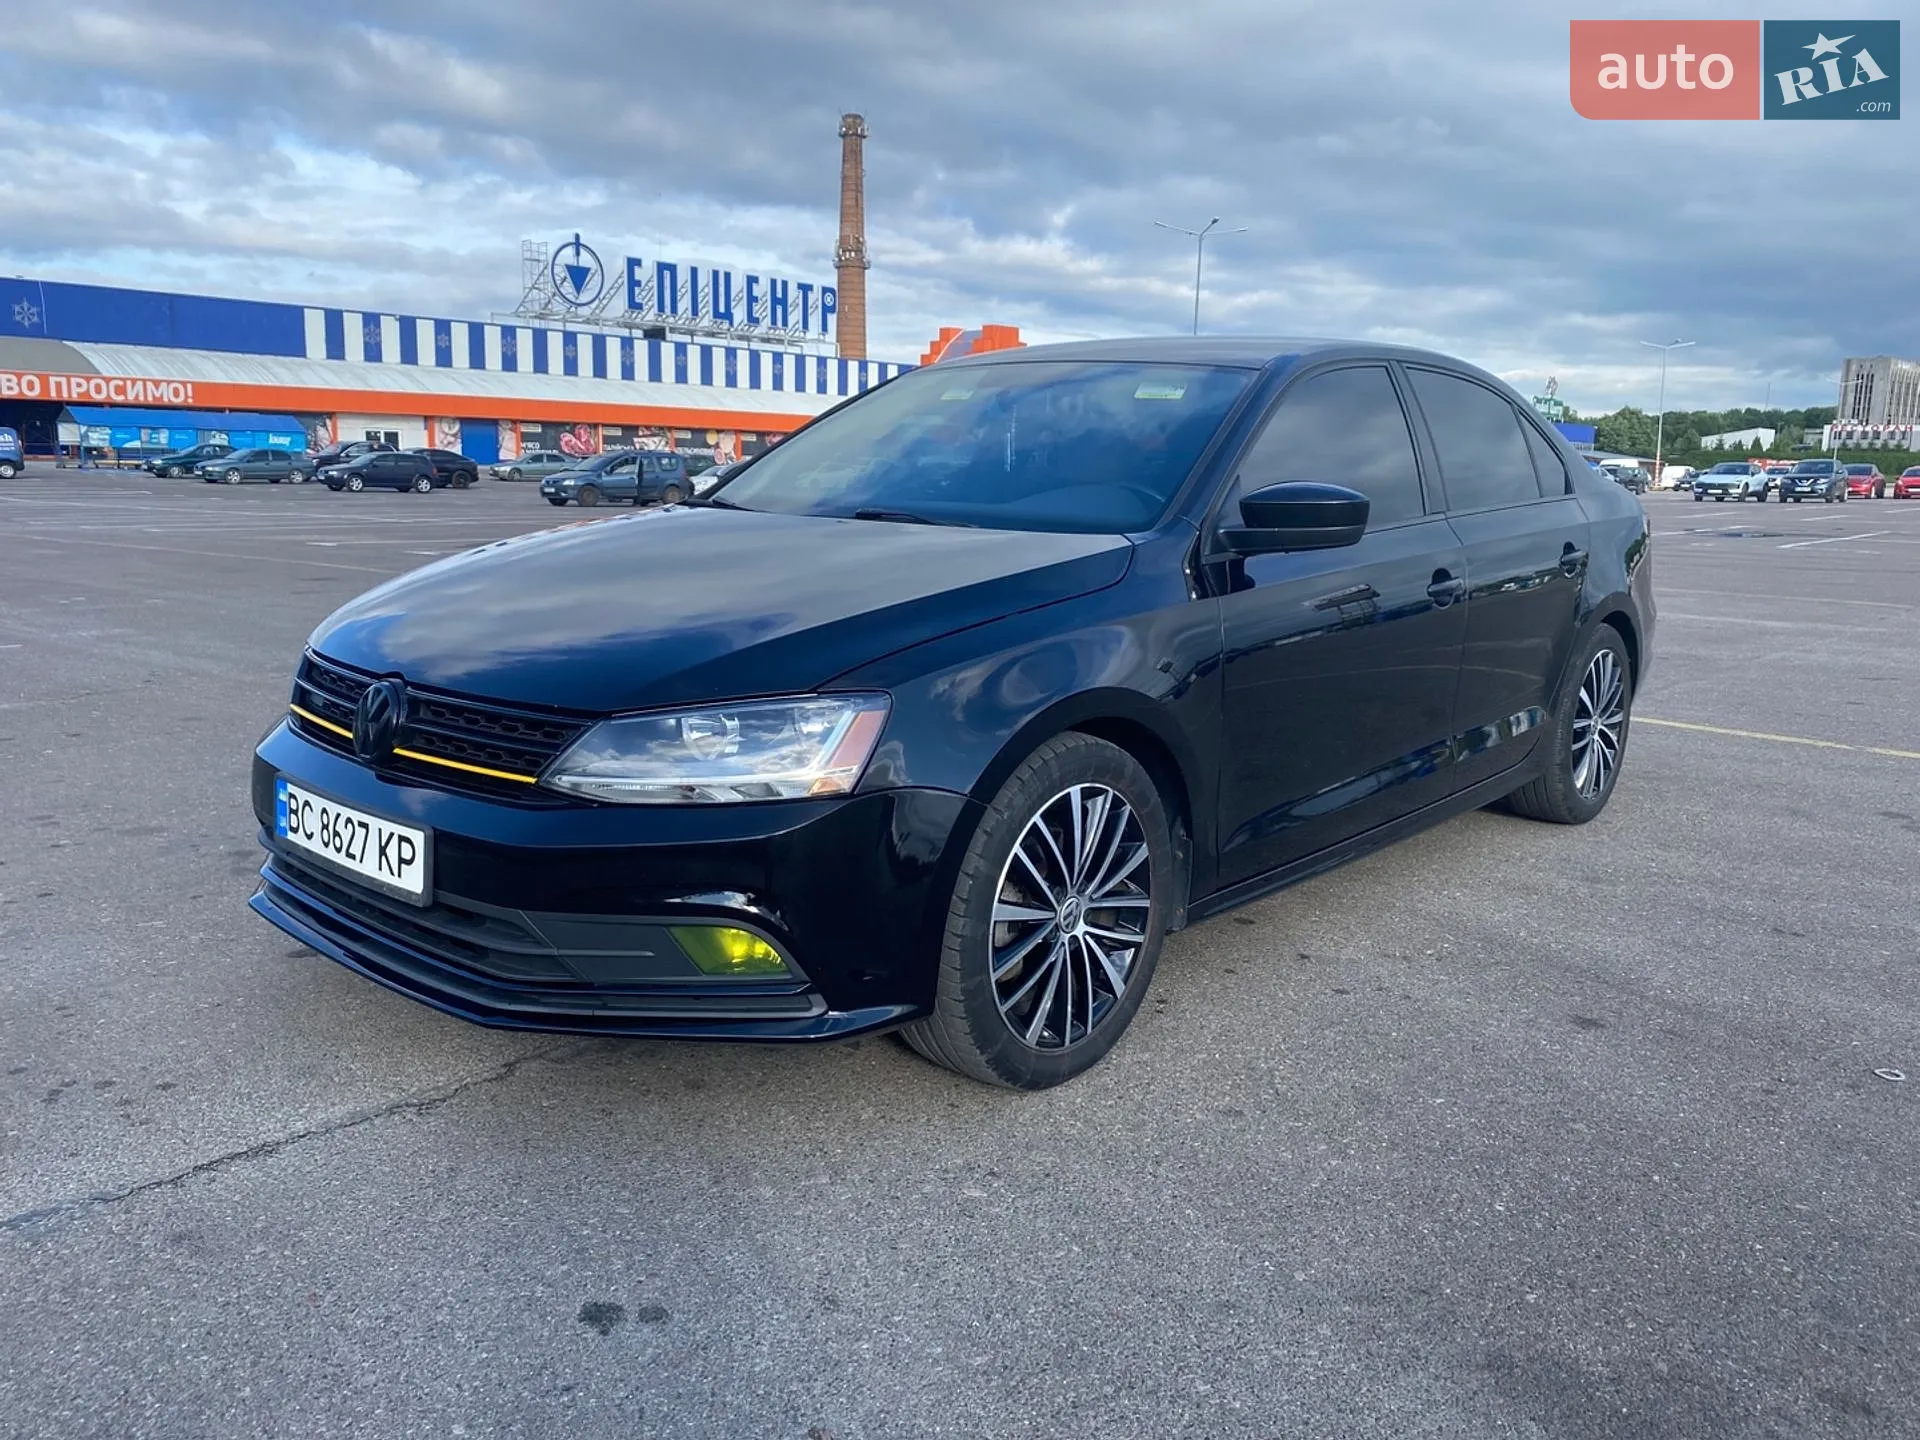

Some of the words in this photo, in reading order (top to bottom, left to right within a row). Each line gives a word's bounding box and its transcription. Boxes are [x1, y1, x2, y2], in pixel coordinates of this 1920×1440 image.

[626, 255, 838, 334] ЕПІЦЕНТР
[49, 375, 193, 403] ПРОСИМО!
[288, 792, 314, 840] BC
[320, 807, 369, 863] 8627
[378, 828, 416, 878] KP
